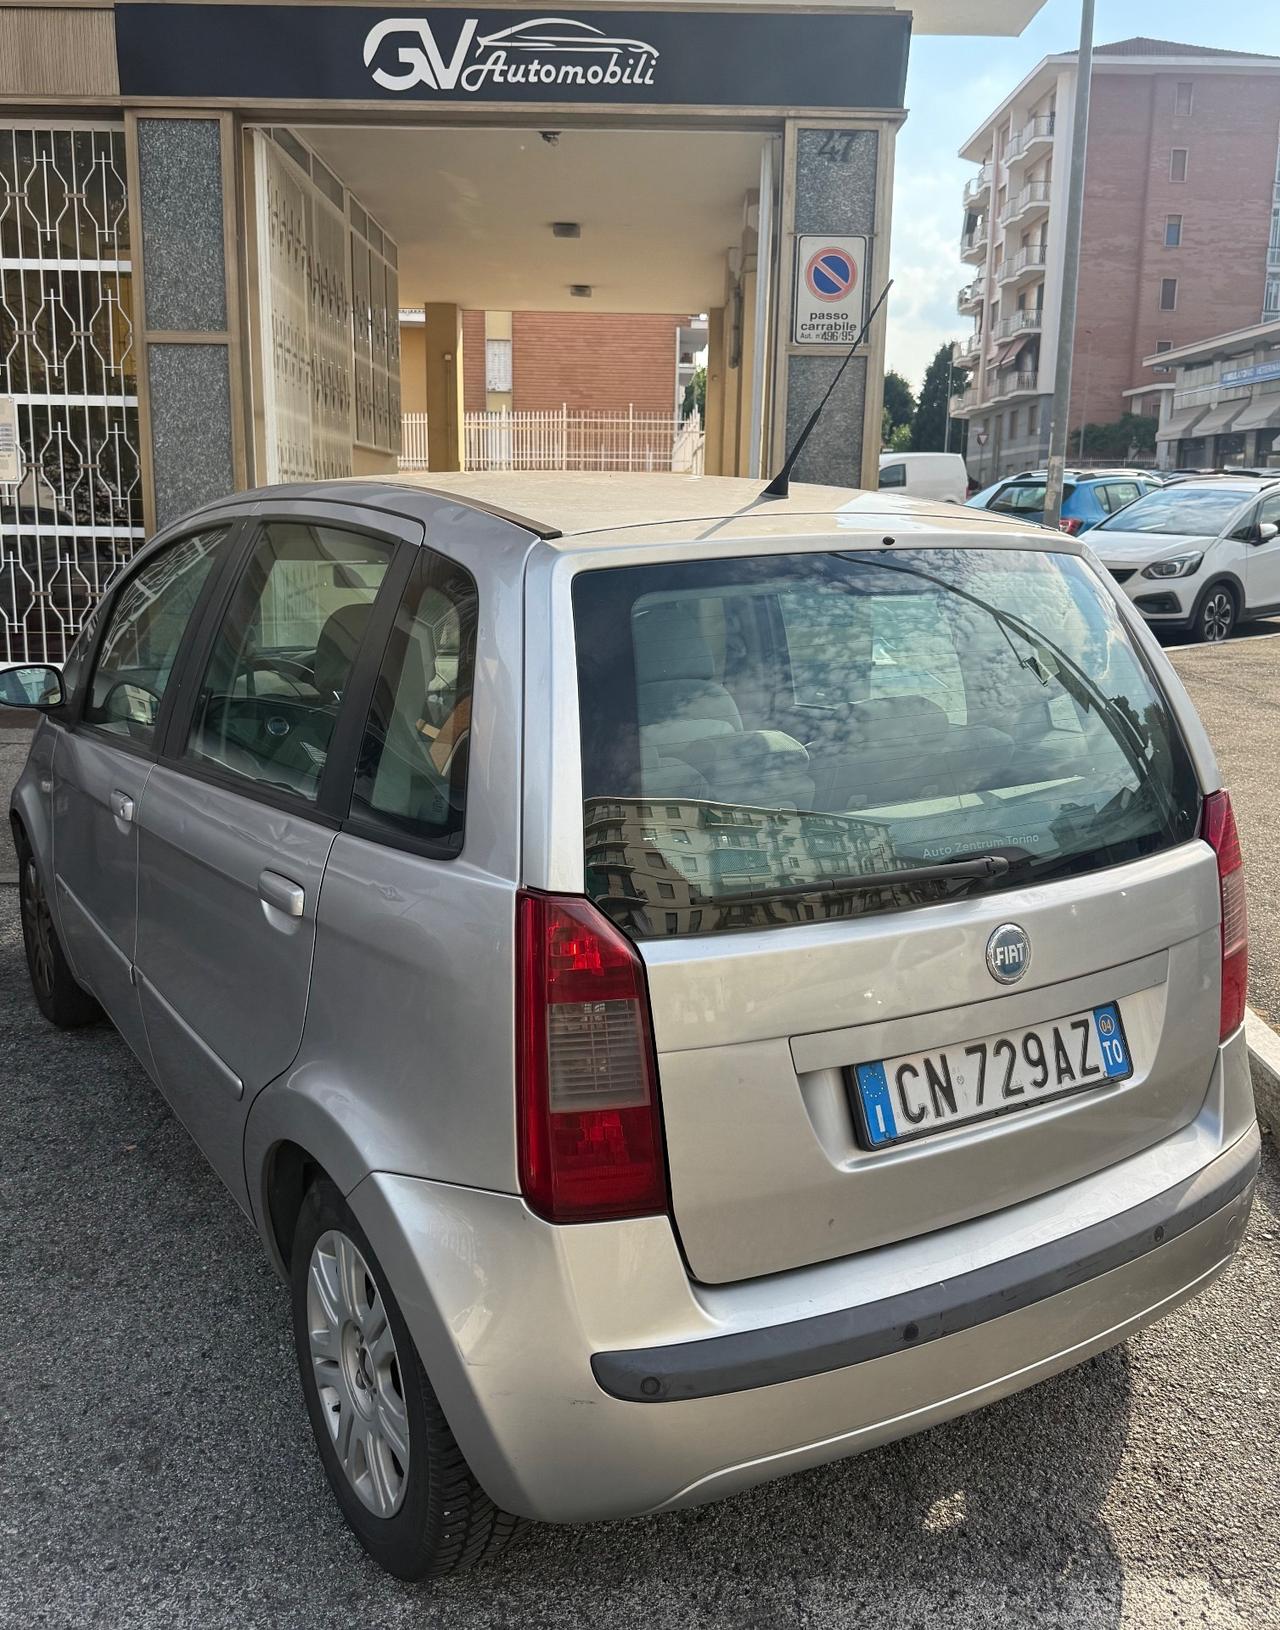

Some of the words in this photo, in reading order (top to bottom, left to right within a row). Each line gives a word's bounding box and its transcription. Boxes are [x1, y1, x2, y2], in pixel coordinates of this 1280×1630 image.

[363, 18, 478, 91] GV
[461, 50, 655, 91] Automobili
[801, 321, 857, 331] carrabile
[810, 312, 849, 322] passo
[922, 846, 952, 859] Auto
[955, 838, 1004, 853] Zentrum
[1006, 833, 1039, 845] Torino
[995, 943, 1025, 965] FIAT
[1103, 1038, 1123, 1066] TO
